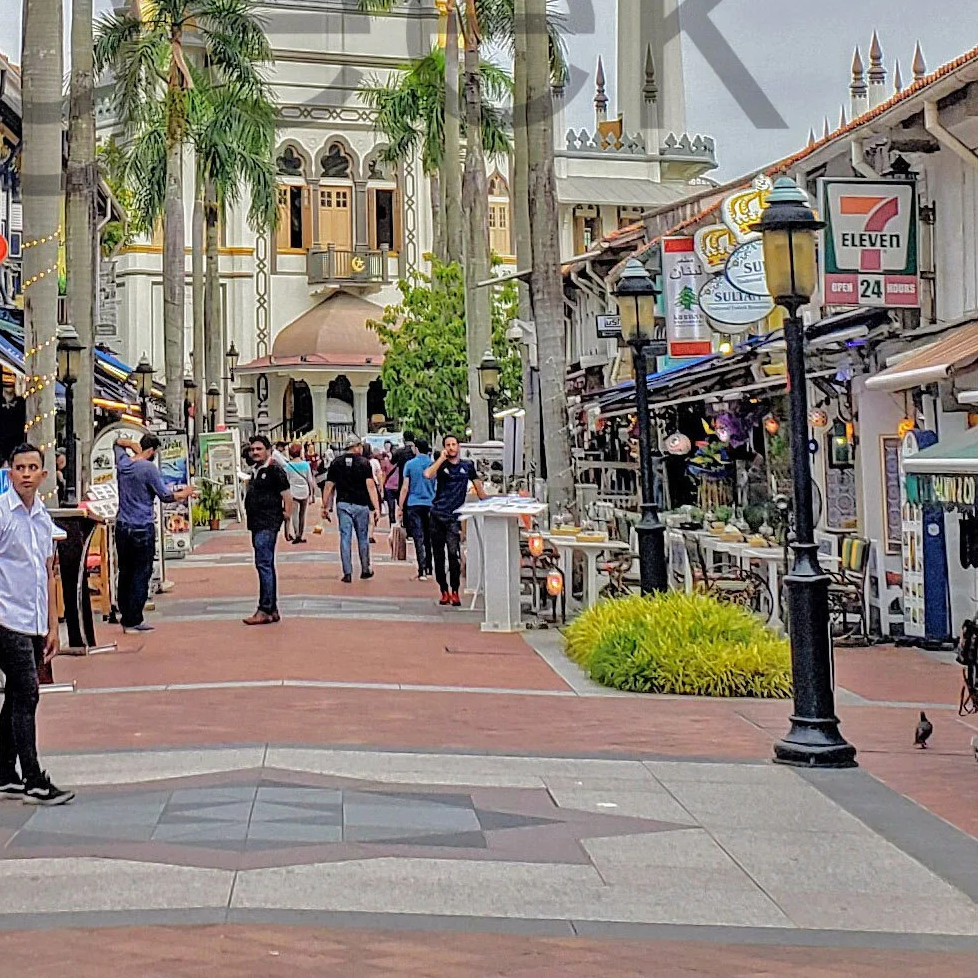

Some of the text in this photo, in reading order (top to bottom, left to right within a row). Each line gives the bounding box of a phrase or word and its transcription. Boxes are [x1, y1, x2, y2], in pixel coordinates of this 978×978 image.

[831, 279, 916, 299] OPEN 24 HOURS
